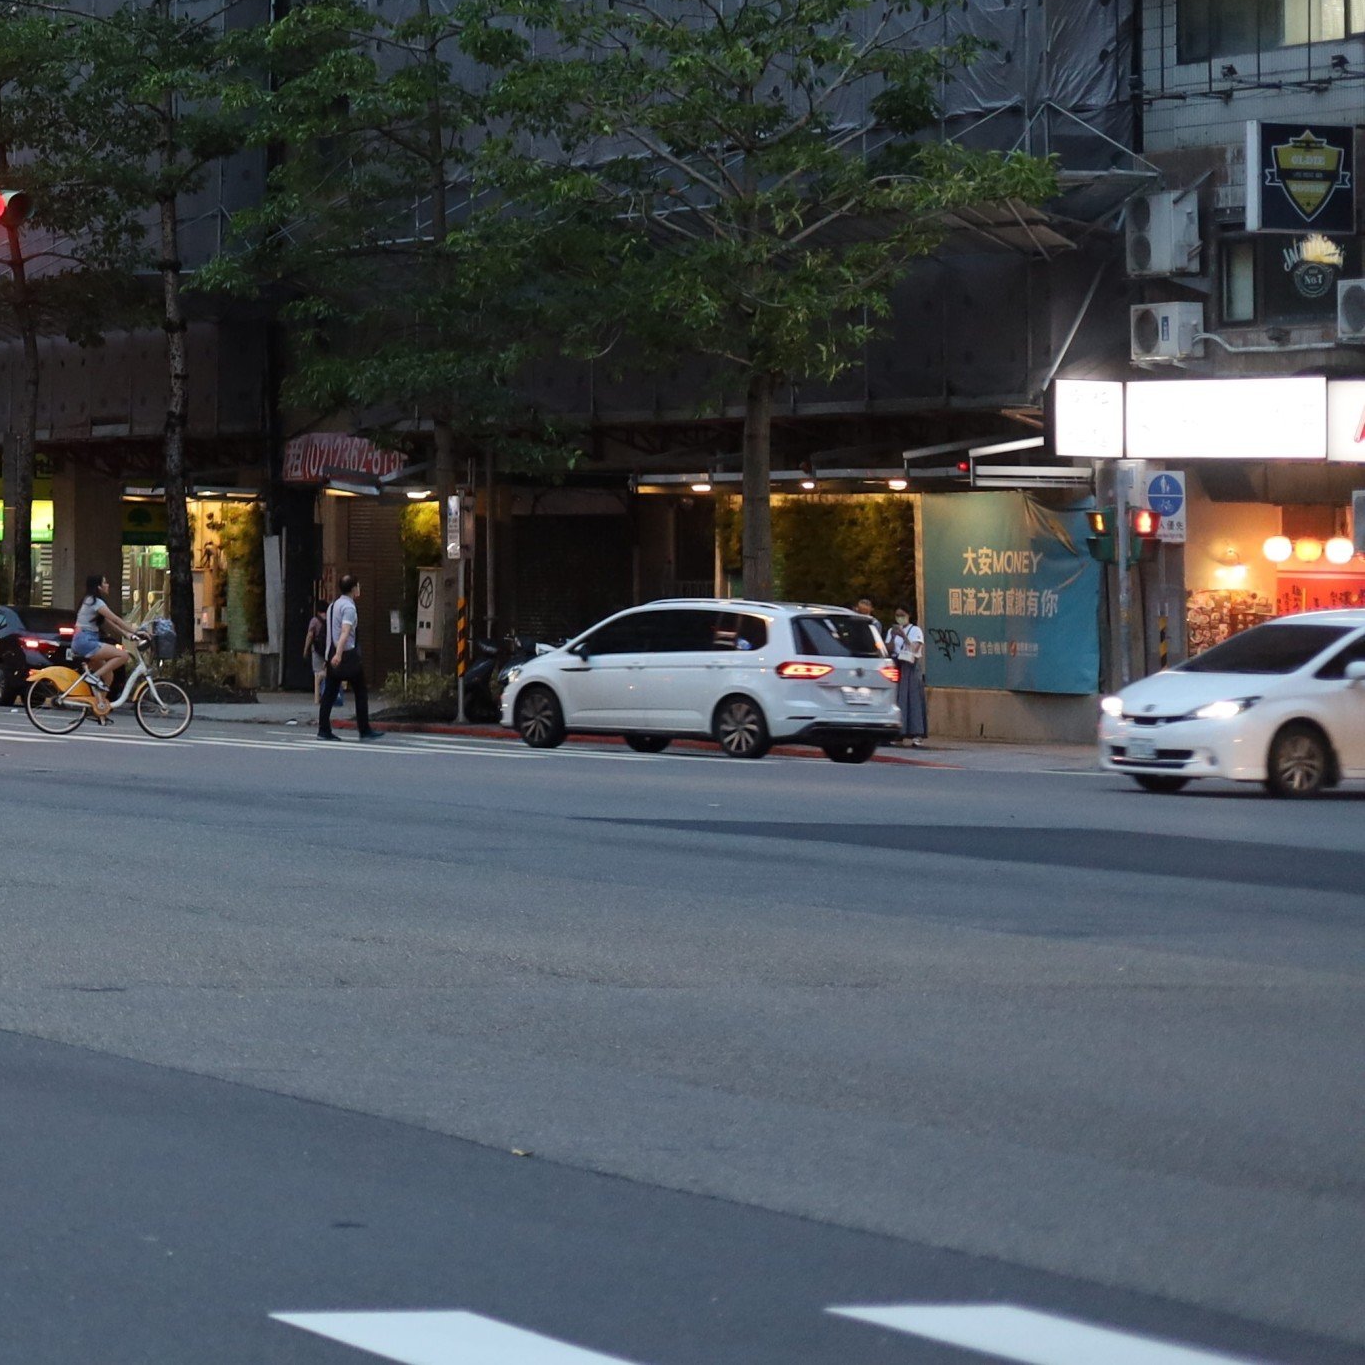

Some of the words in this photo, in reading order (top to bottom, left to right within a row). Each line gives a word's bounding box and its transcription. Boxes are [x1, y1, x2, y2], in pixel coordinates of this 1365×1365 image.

[962, 546, 1043, 576] 大安MONEY
[948, 588, 1059, 618] 圓滿之旅感謝有你
